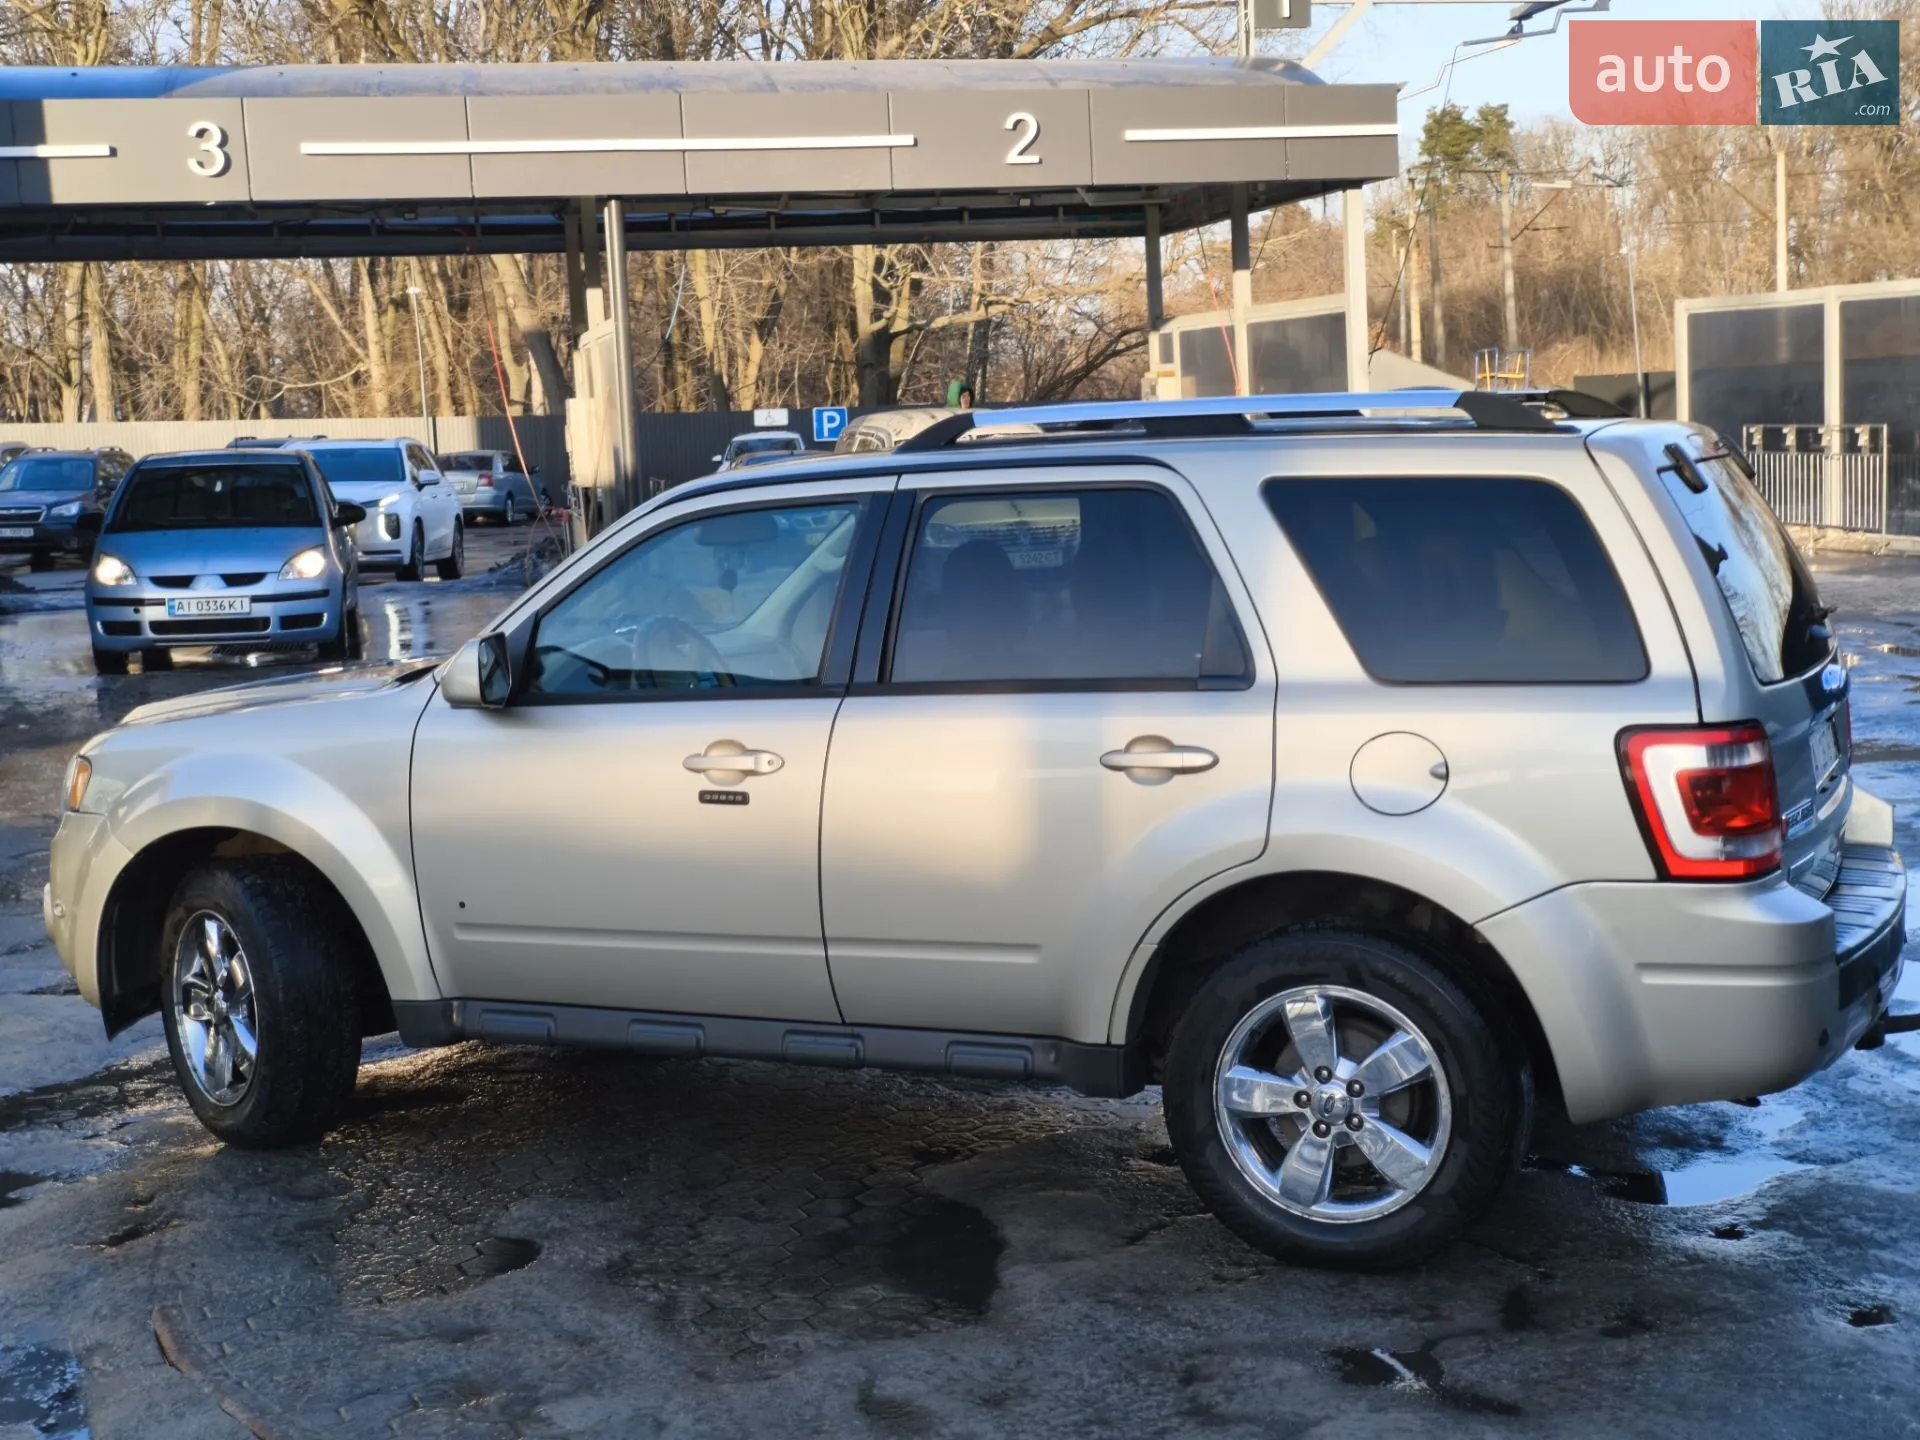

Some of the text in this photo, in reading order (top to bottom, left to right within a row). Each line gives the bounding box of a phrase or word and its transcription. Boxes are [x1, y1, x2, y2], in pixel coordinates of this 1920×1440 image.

[187, 120, 226, 177] 3
[1004, 111, 1041, 165] 2
[822, 410, 841, 437] P
